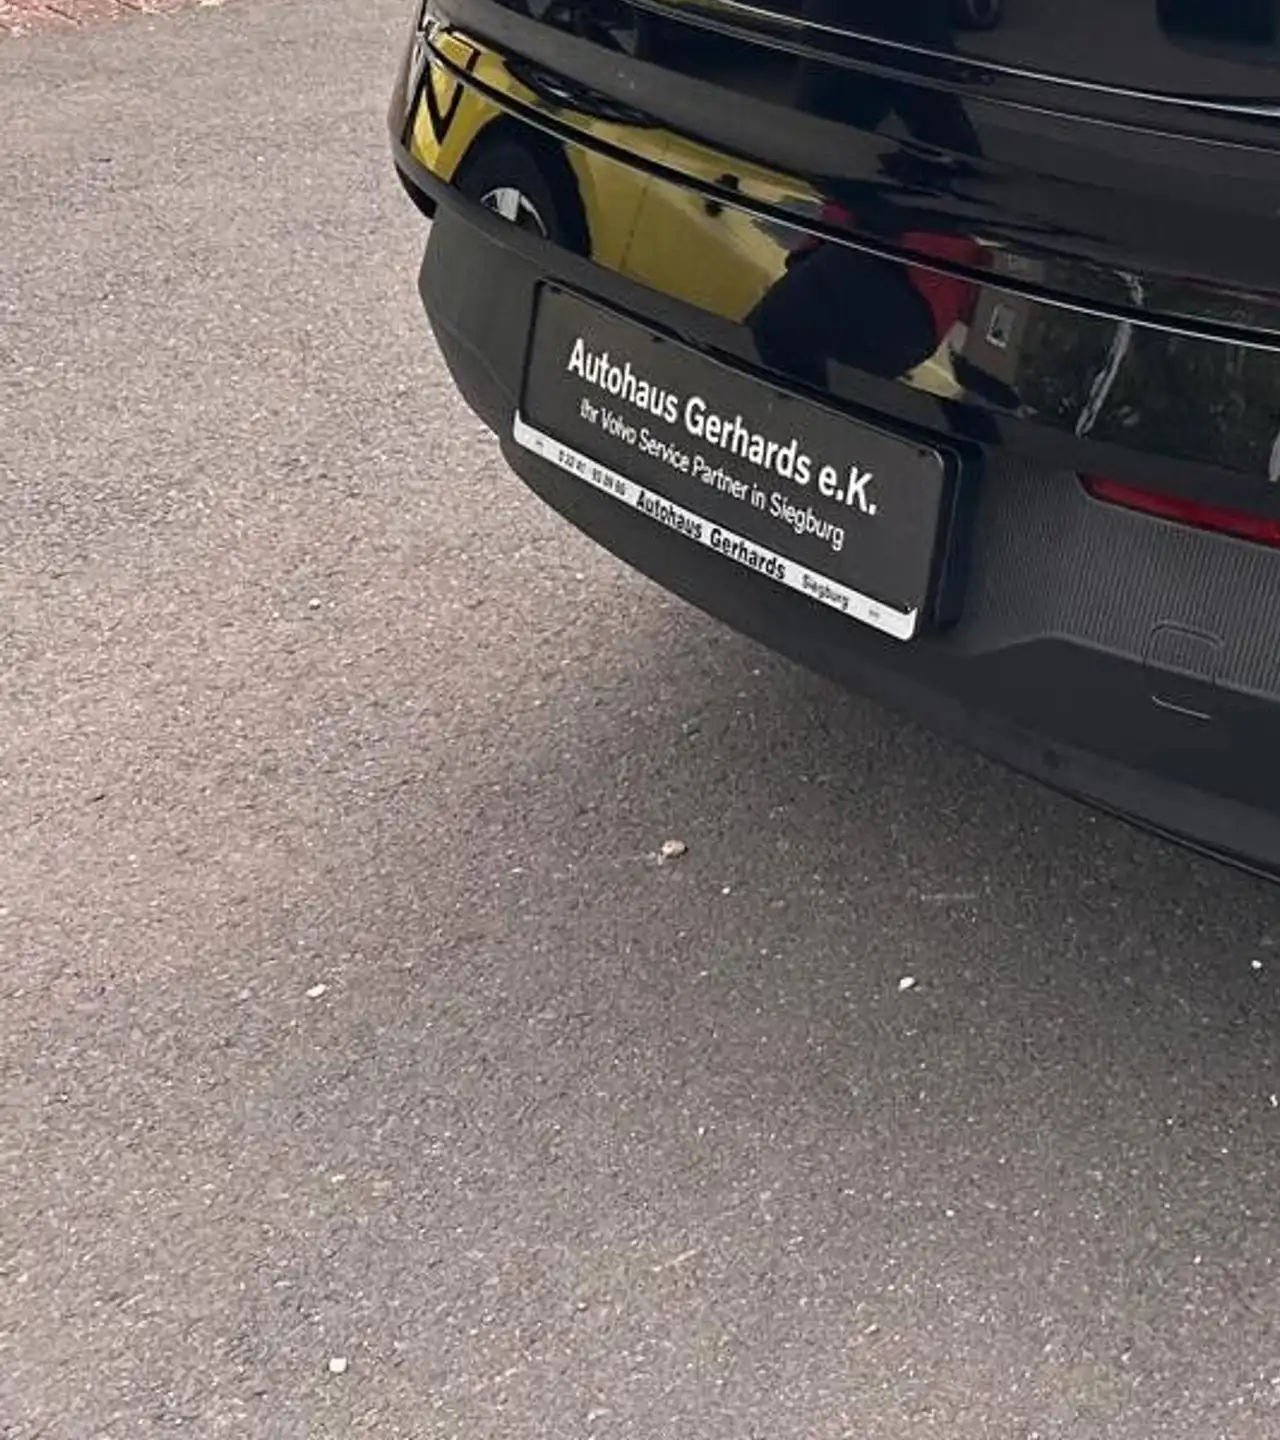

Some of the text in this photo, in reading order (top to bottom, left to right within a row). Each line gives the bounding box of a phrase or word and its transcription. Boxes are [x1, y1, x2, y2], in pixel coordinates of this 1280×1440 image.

[567, 337, 877, 515] Autohaus Gerhards e.K.
[580, 398, 845, 551] Ihr Volvo Service Partner in Siegburg
[636, 490, 703, 539] Autohaus
[710, 528, 786, 580] Gerhards
